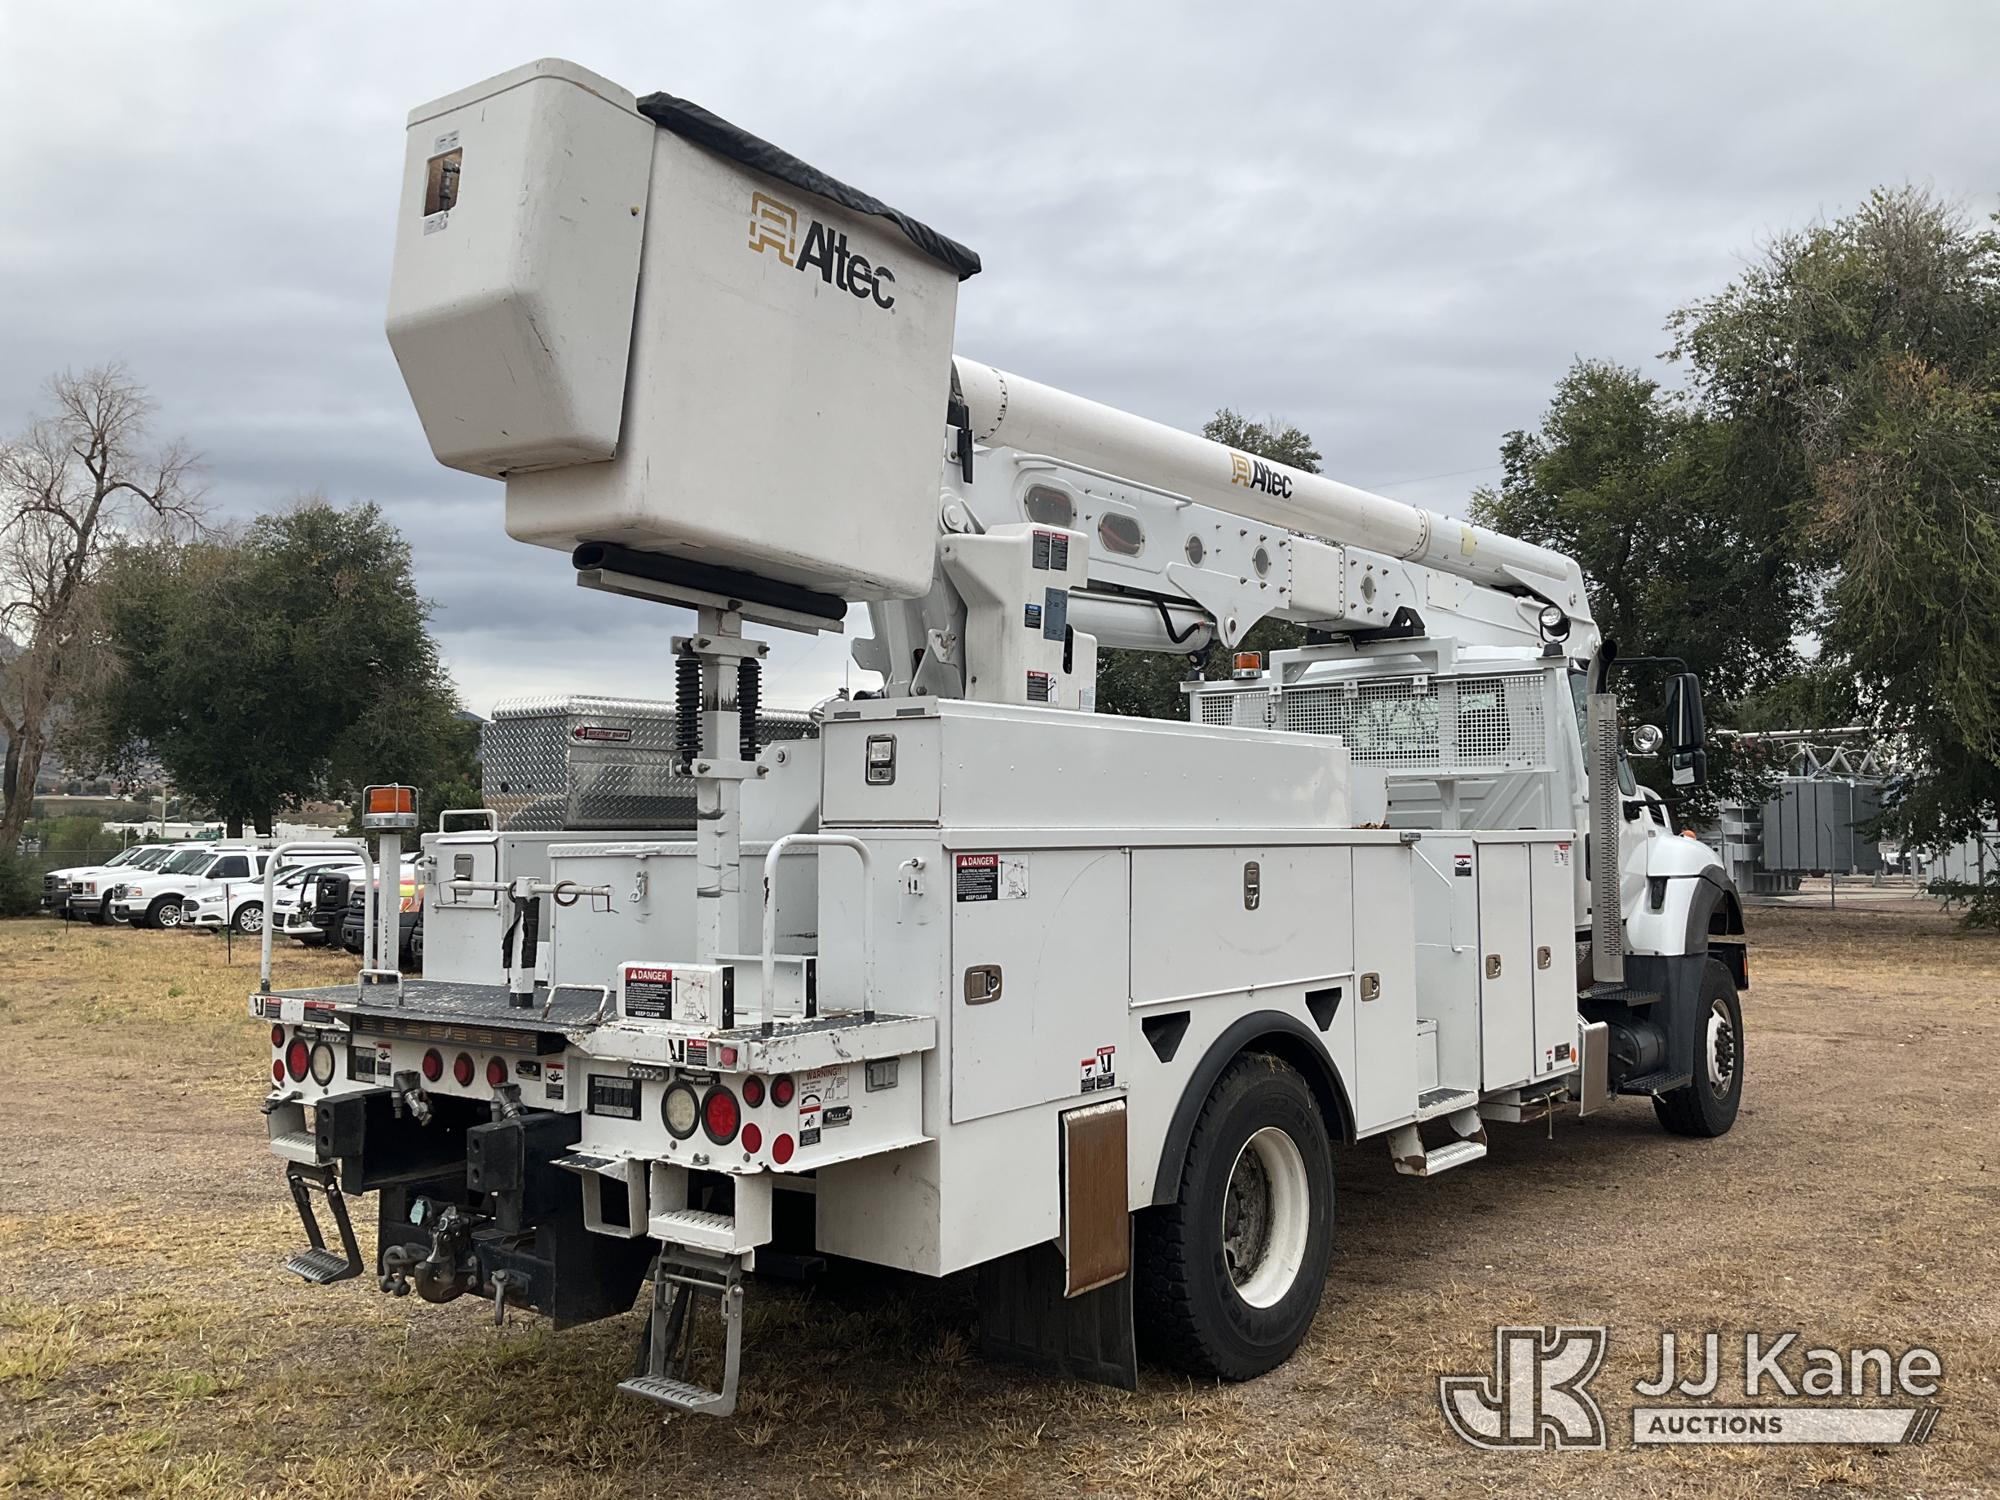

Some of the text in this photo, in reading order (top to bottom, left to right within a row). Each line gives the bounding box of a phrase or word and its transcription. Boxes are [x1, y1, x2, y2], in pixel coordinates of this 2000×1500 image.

[795, 219, 896, 310] Altec
[1249, 459, 1293, 500] Altec
[968, 856, 994, 866] DANGER
[638, 970, 667, 980] DANGER
